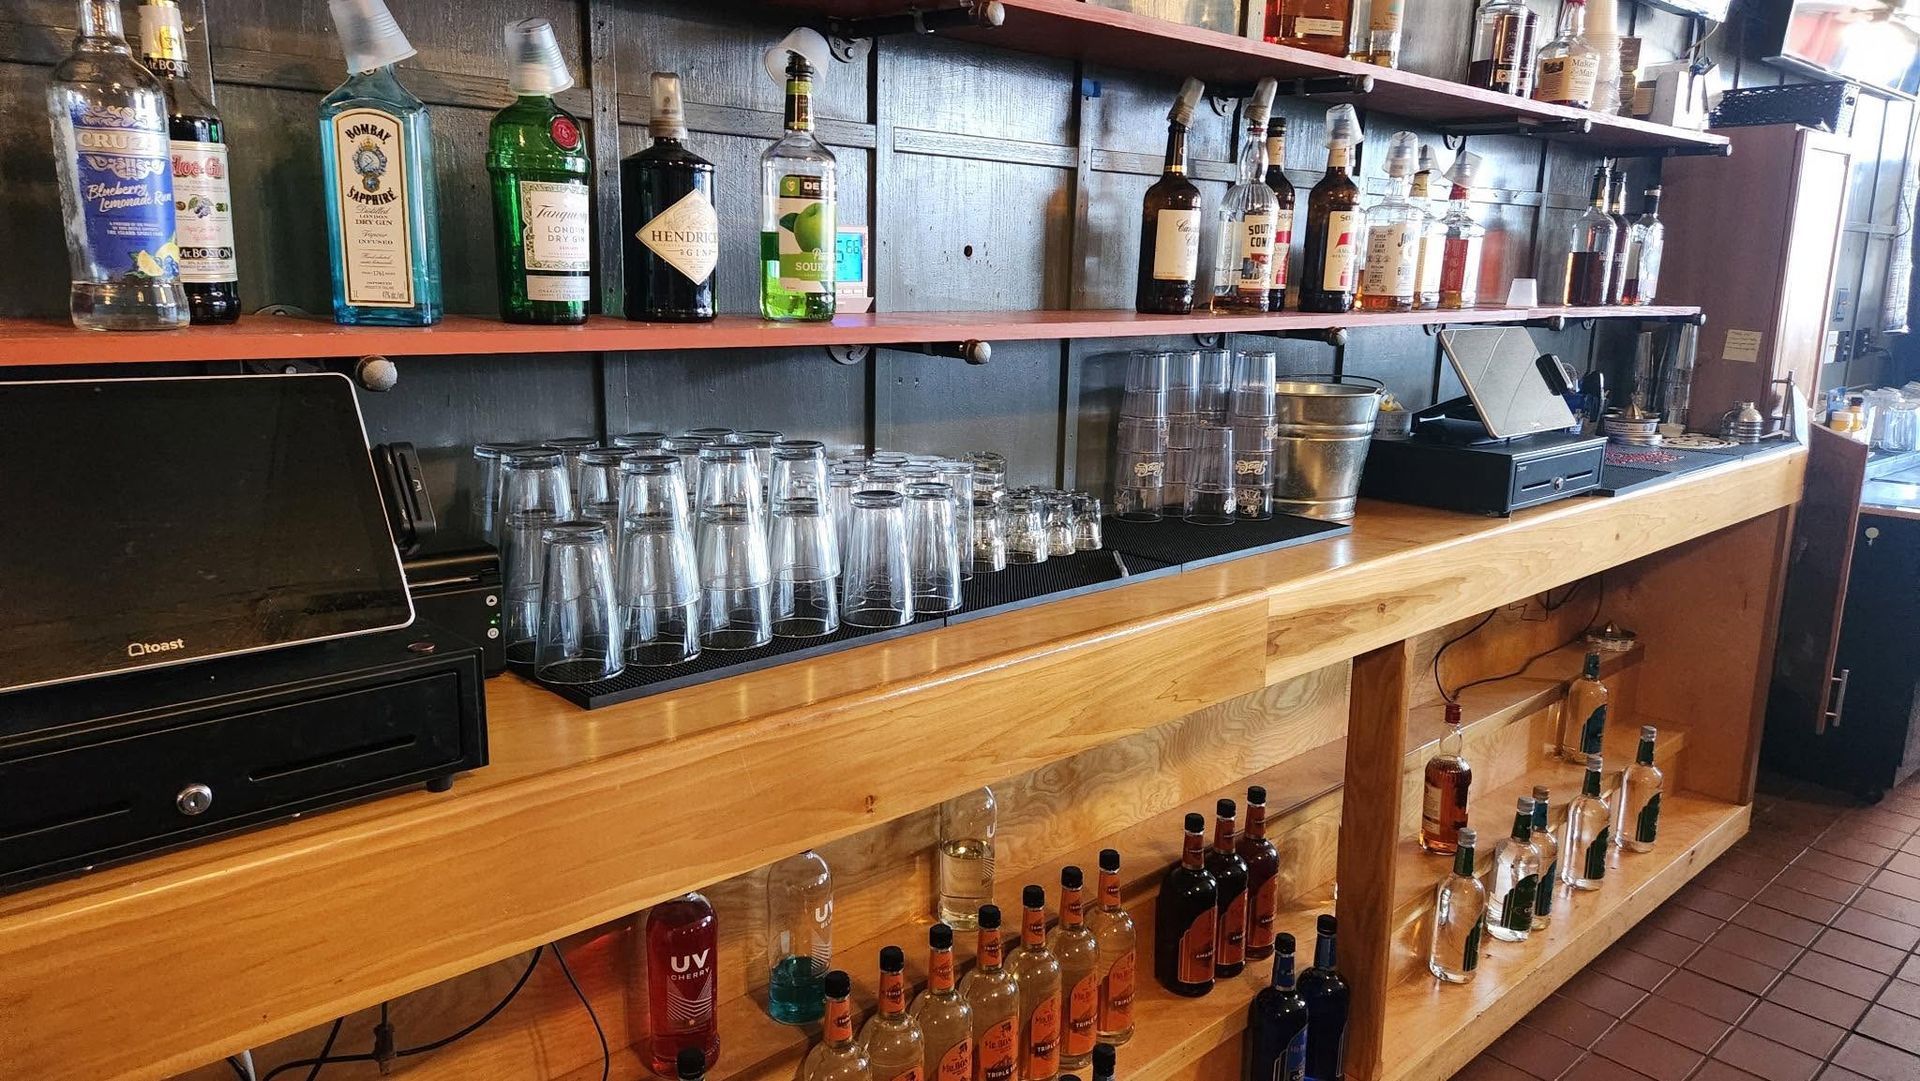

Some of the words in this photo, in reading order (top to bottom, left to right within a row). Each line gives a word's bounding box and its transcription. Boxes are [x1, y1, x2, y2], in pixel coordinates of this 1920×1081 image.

[345, 124, 392, 142] BOMBAY
[87, 181, 148, 201] Blueberry
[346, 185, 398, 206] SAPPHIRE
[99, 192, 153, 212] Lemonade
[536, 204, 587, 223] Tanquy
[193, 248, 231, 259] BOSTON
[144, 638, 184, 653] toast
[670, 949, 710, 973] UV
[670, 966, 710, 981] CHERRY
[987, 1066, 1009, 1079] TRIPLE
